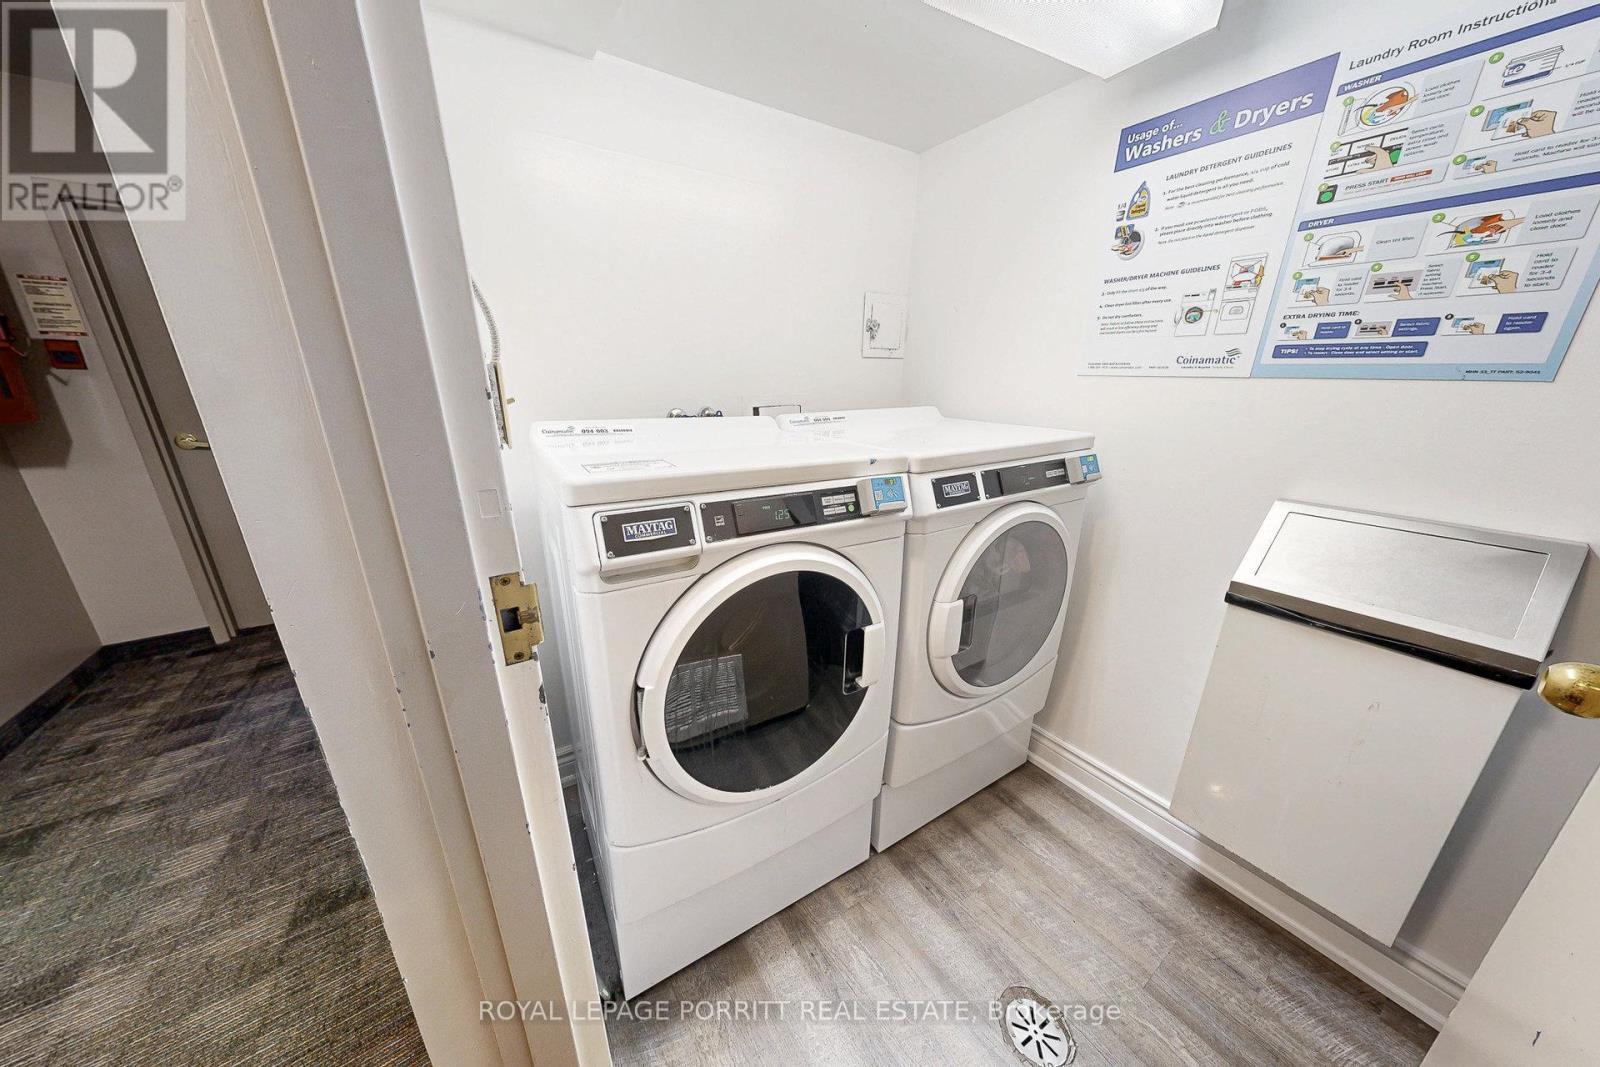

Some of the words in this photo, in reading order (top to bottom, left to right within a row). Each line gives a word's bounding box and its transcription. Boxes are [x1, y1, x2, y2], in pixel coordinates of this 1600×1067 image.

[1348, 44, 1405, 71] Laundry
[1407, 29, 1452, 52] Room
[1343, 74, 1382, 92] WASHER
[1125, 126, 1203, 162] Washers
[1208, 110, 1231, 135] &
[1234, 92, 1314, 129] Dryers
[1127, 129, 1159, 144] Usage
[1166, 168, 1199, 181] LAUNDRY
[1200, 156, 1242, 173] DETERGENT
[1244, 142, 1293, 161] GUIDELINES
[1345, 183, 1366, 191] PRESS
[1368, 178, 1389, 186] START
[1308, 218, 1334, 228] DRYER
[1104, 274, 1148, 284] WASHER/DRYER
[1150, 270, 1179, 278] MACHINE
[1180, 264, 1221, 275] GUIDELINES
[1308, 311, 1336, 319] DRYING
[1176, 355, 1236, 365] Coinamatic
[626, 520, 673, 536] MAYTAG
